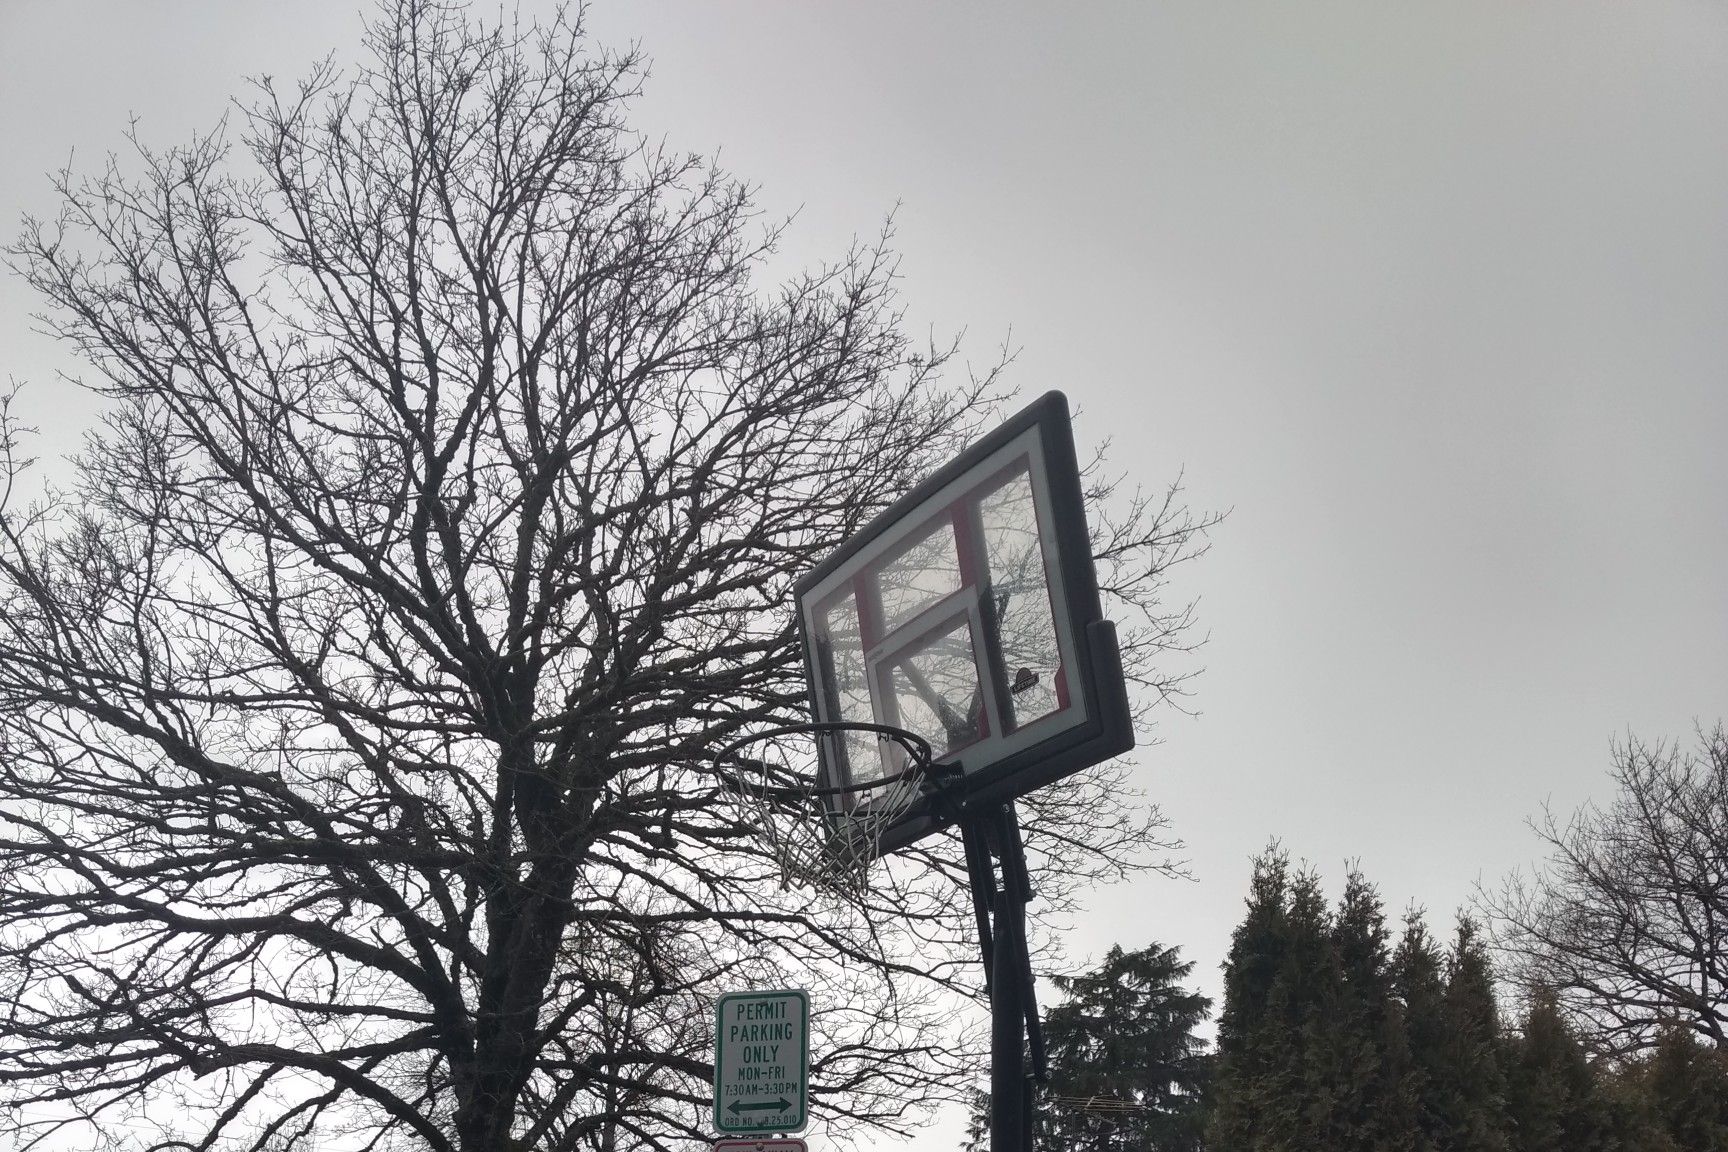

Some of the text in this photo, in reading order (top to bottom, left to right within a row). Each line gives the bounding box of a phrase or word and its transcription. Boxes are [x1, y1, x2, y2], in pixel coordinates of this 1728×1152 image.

[737, 1001, 787, 1020] PERMIT
[731, 1023, 793, 1042] PARKING
[743, 1045, 779, 1063] ONLY
[738, 1066, 785, 1081] MON-FRI
